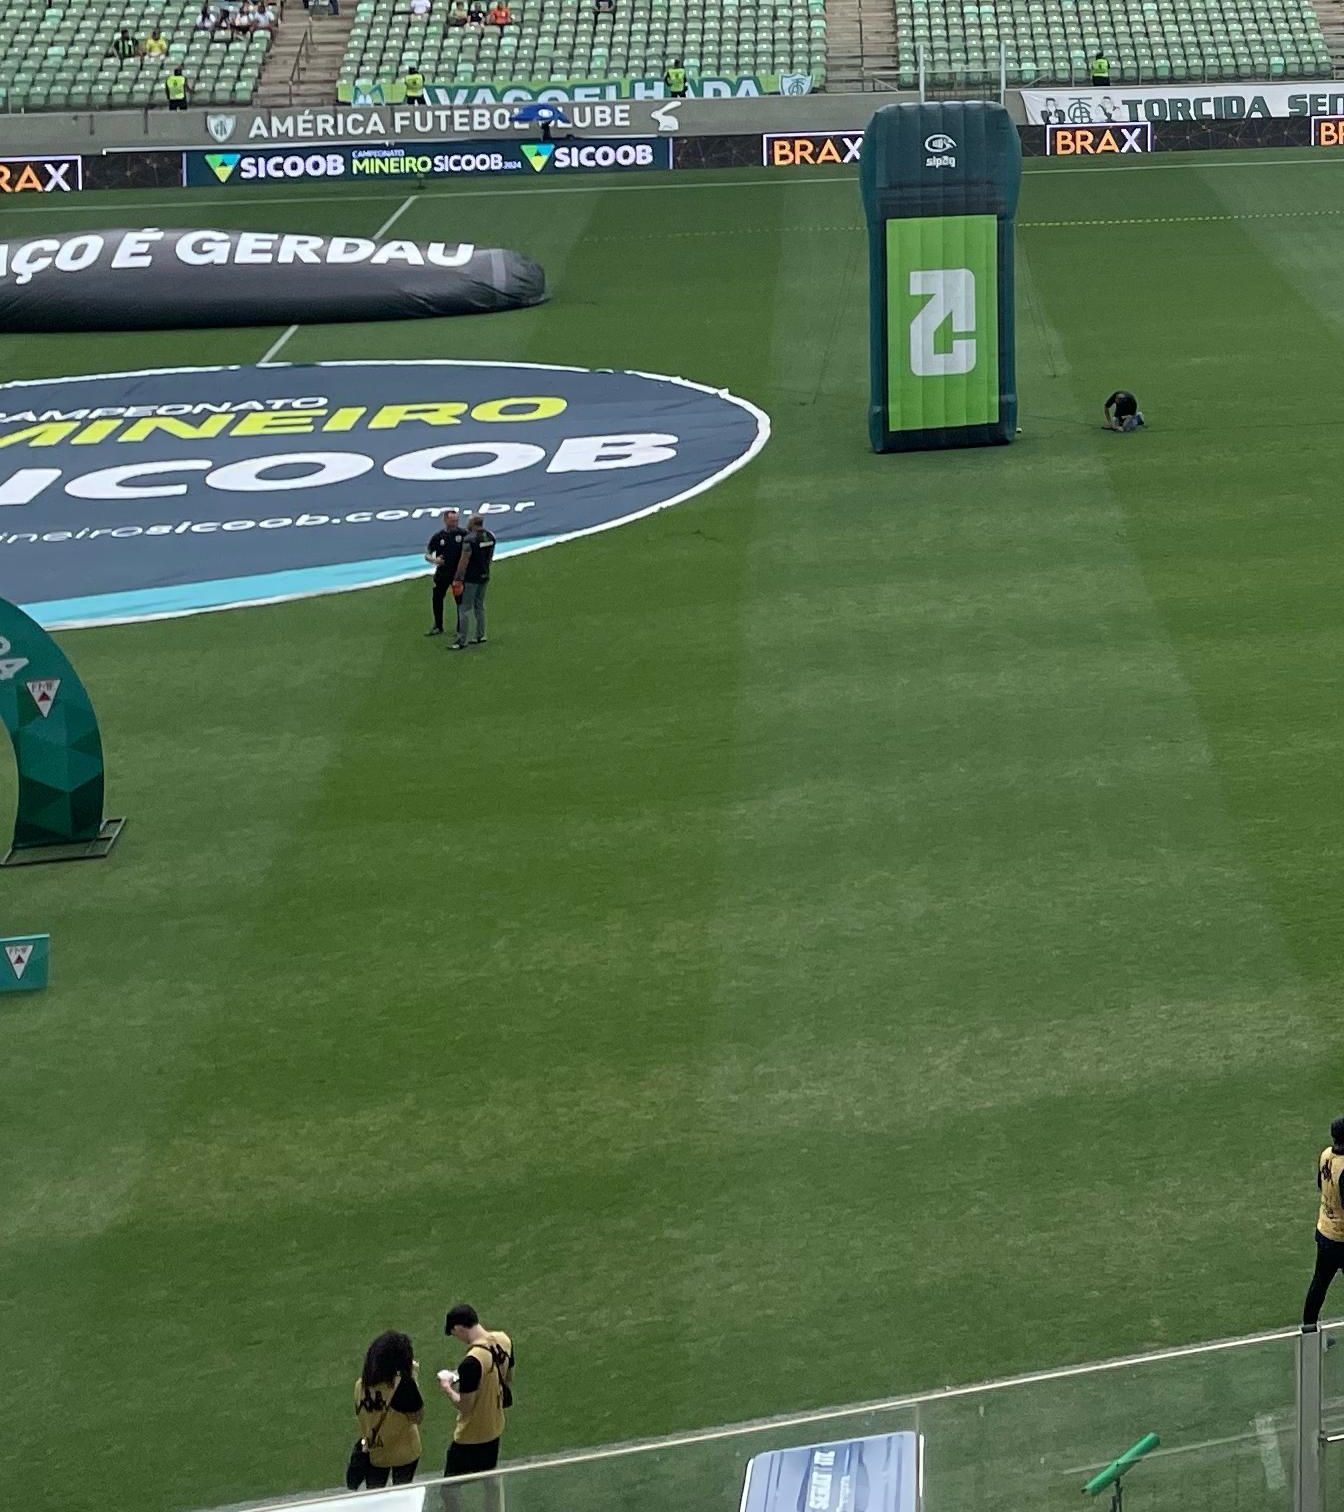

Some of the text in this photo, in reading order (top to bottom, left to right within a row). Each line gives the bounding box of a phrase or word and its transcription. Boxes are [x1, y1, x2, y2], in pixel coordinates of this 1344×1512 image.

[1122, 94, 1268, 121] TORCIDA
[248, 108, 386, 138] AMÉRICA
[774, 136, 864, 166] BRAX
[1055, 127, 1141, 155] BRAX
[241, 153, 345, 179] SICOOB
[352, 156, 431, 175] MINEIRO
[434, 153, 502, 173] SICOOB
[553, 144, 653, 169] SICOOB
[111, 227, 164, 268] É
[176, 230, 475, 267] GERDAU
